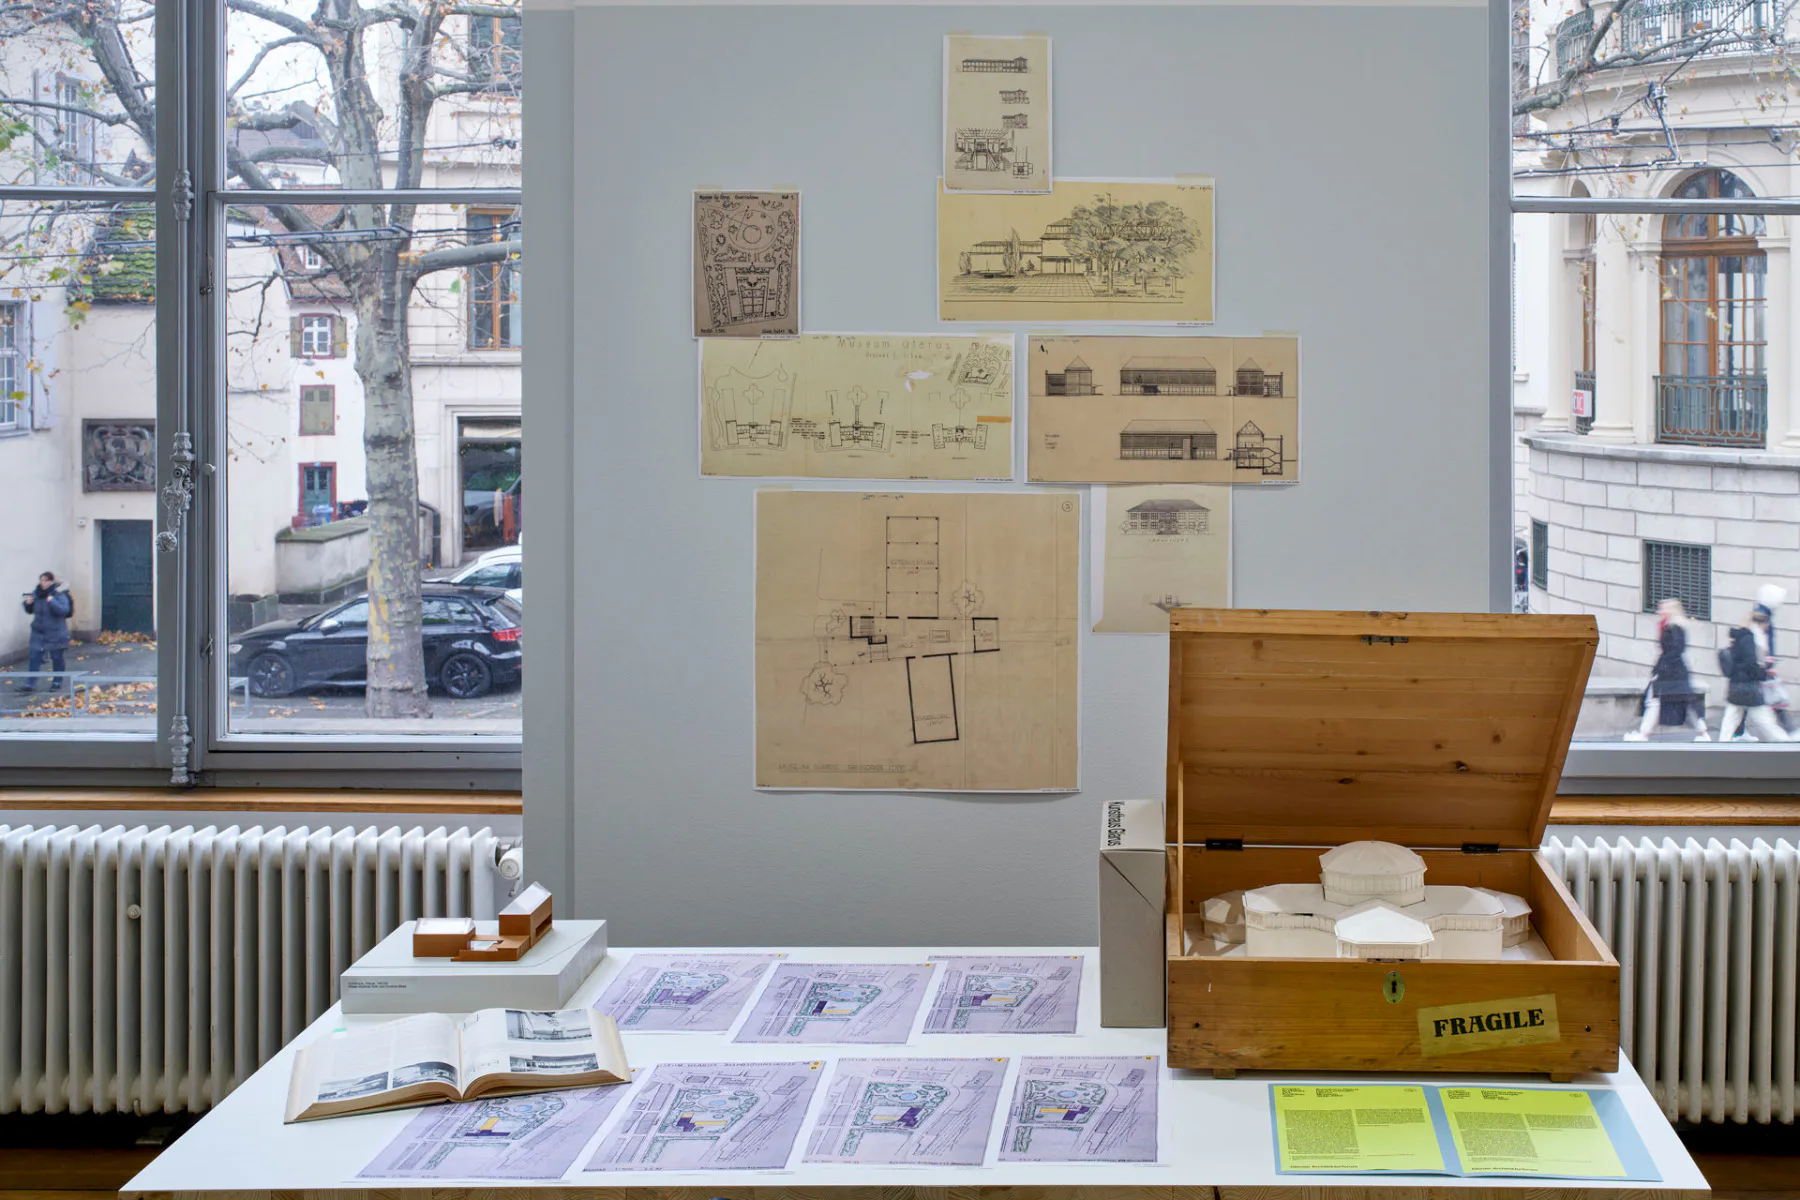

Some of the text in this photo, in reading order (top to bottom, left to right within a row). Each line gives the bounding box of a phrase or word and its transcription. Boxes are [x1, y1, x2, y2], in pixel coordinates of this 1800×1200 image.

[838, 339, 890, 349] Museum
[1107, 828, 1126, 847] Glarus
[1432, 1008, 1545, 1038] FRAGILE
